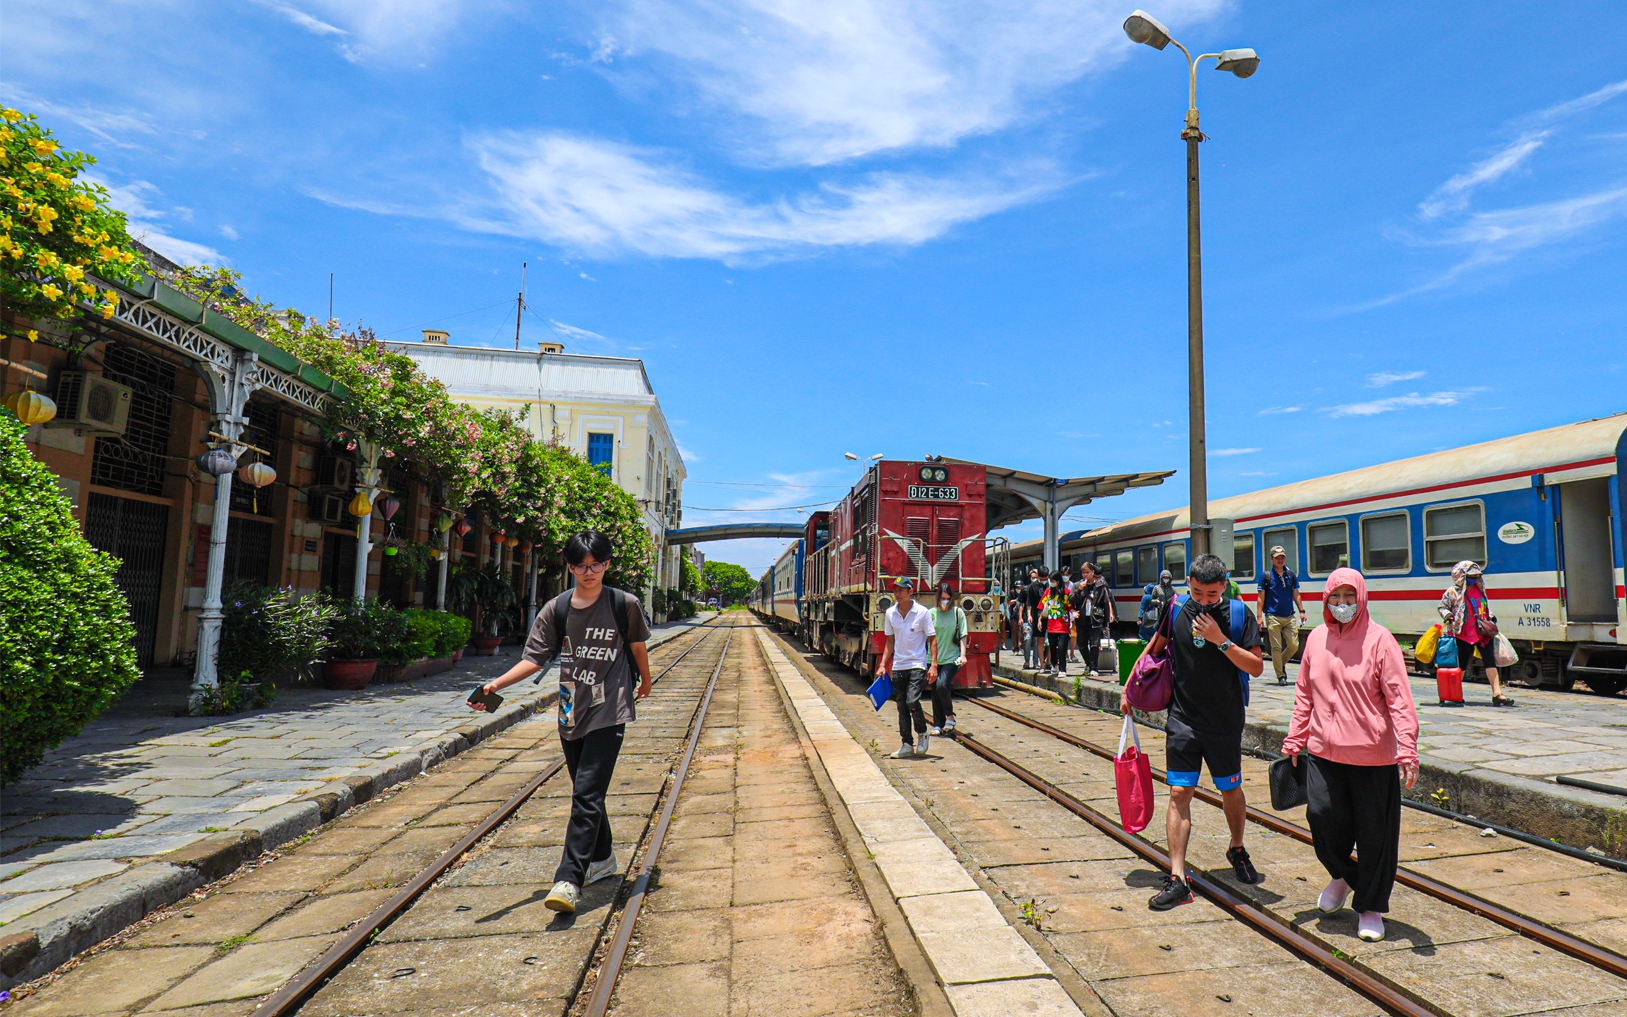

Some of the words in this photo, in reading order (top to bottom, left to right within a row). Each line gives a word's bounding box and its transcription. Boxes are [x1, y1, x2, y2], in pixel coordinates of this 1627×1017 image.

[1523, 603, 1542, 614] VNR
[1518, 616, 1525, 627] A
[1526, 616, 1551, 628] 31558
[585, 627, 616, 641] THE
[575, 646, 617, 662] GREEN
[572, 666, 597, 686] LAB
